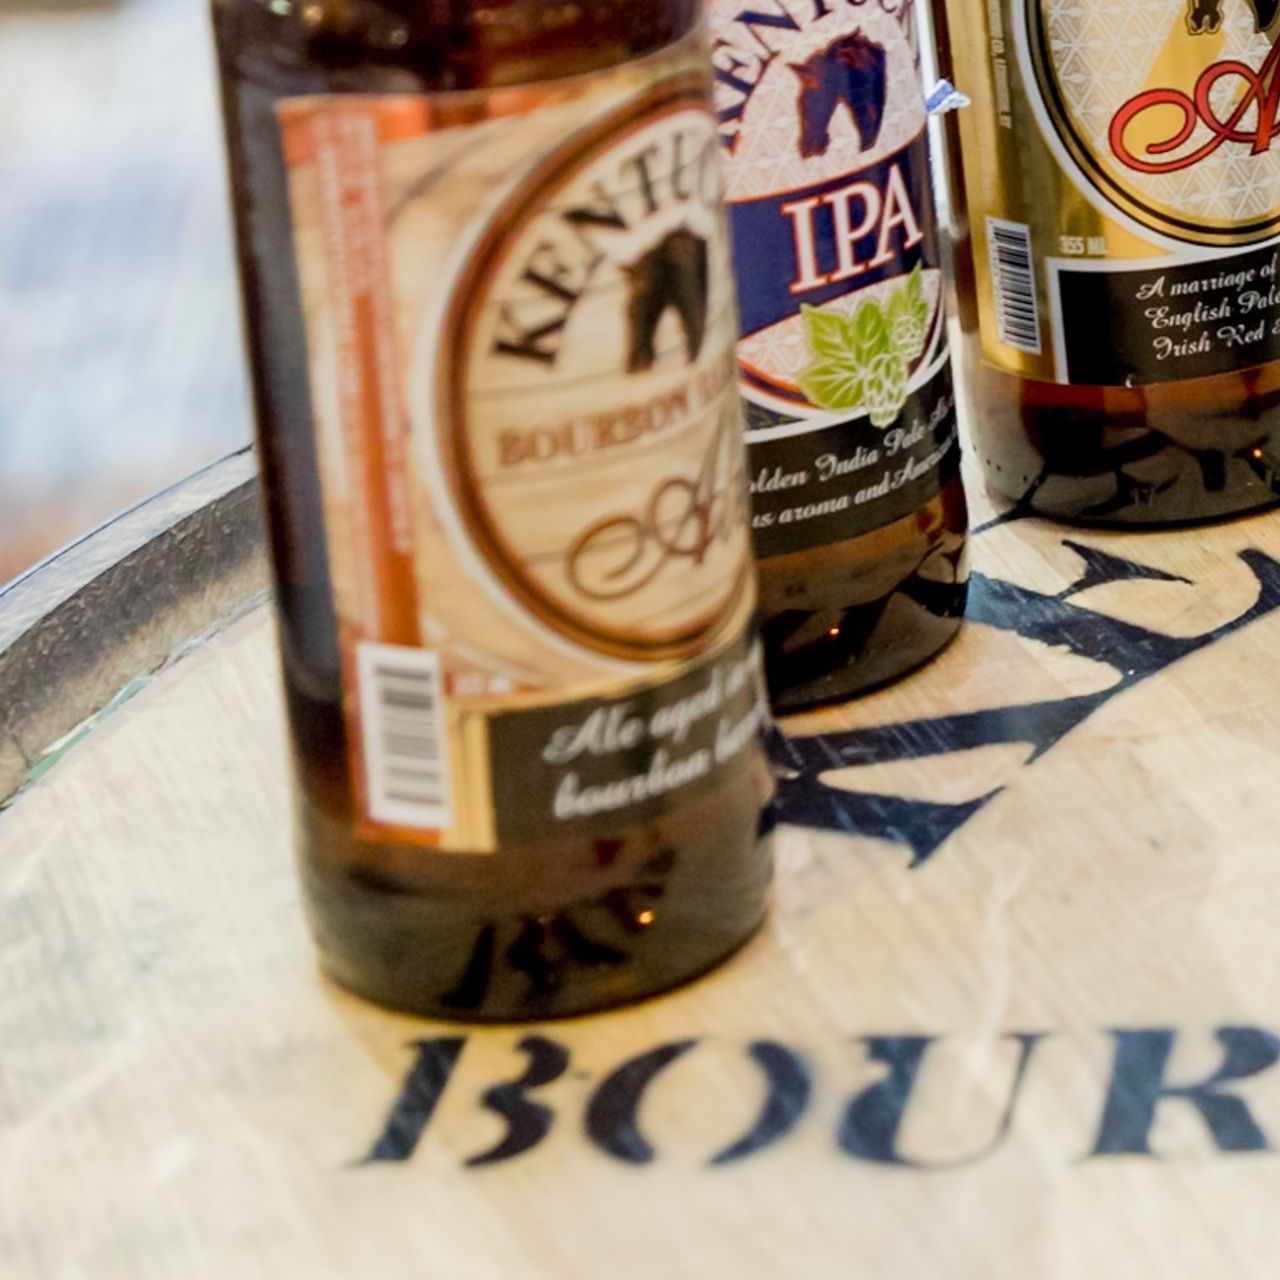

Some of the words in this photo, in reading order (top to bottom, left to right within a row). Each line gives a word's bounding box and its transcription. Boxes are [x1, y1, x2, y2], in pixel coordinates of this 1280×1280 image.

[781, 162, 924, 296] IPA
[1136, 276, 1165, 300] A
[1170, 269, 1256, 297] marriage
[1260, 252, 1278, 281] of
[1144, 298, 1232, 332] English
[1153, 331, 1211, 360] Irish
[1217, 320, 1265, 347] Red
[496, 388, 692, 467] BOURBON
[815, 446, 879, 482] India
[778, 494, 849, 524] aroma
[854, 472, 891, 504] and
[541, 701, 645, 765] Ale
